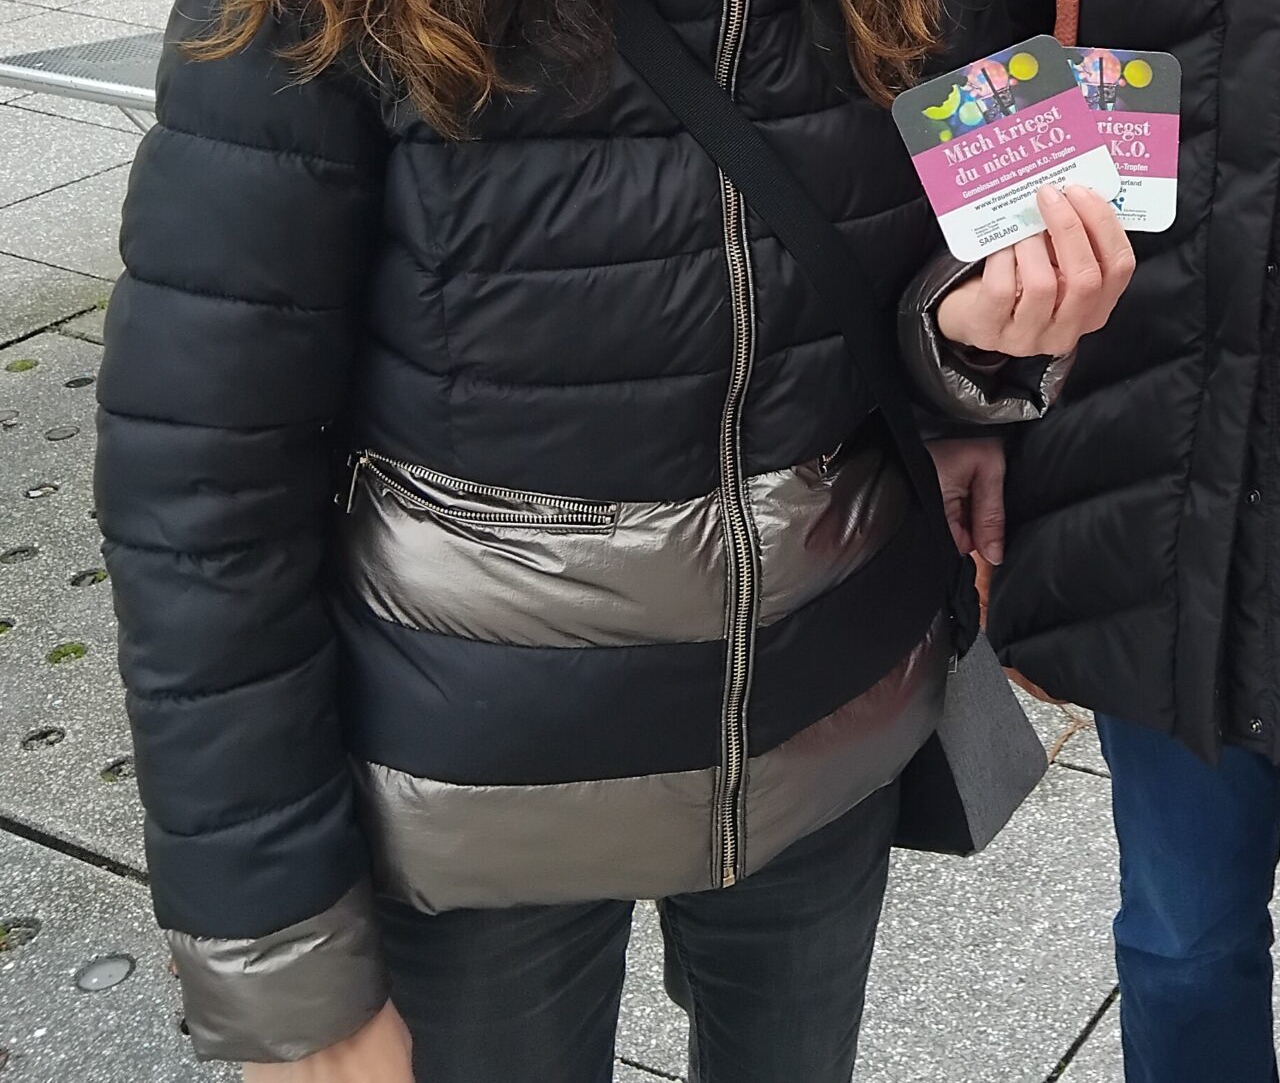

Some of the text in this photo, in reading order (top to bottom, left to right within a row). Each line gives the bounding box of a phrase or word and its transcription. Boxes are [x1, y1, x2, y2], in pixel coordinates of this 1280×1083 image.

[942, 106, 1062, 167] Mich kriegst
[1096, 117, 1151, 142] riegst
[955, 127, 1071, 187] du nicht K.O.
[1111, 139, 1150, 158] K.O.
[962, 178, 1000, 199] Gemeinsam
[1000, 170, 1017, 183] stark
[1018, 163, 1037, 177] gegen
[974, 162, 1077, 211] www.frauenbeauftragte.saarland
[979, 224, 1019, 247] SAARLAND
